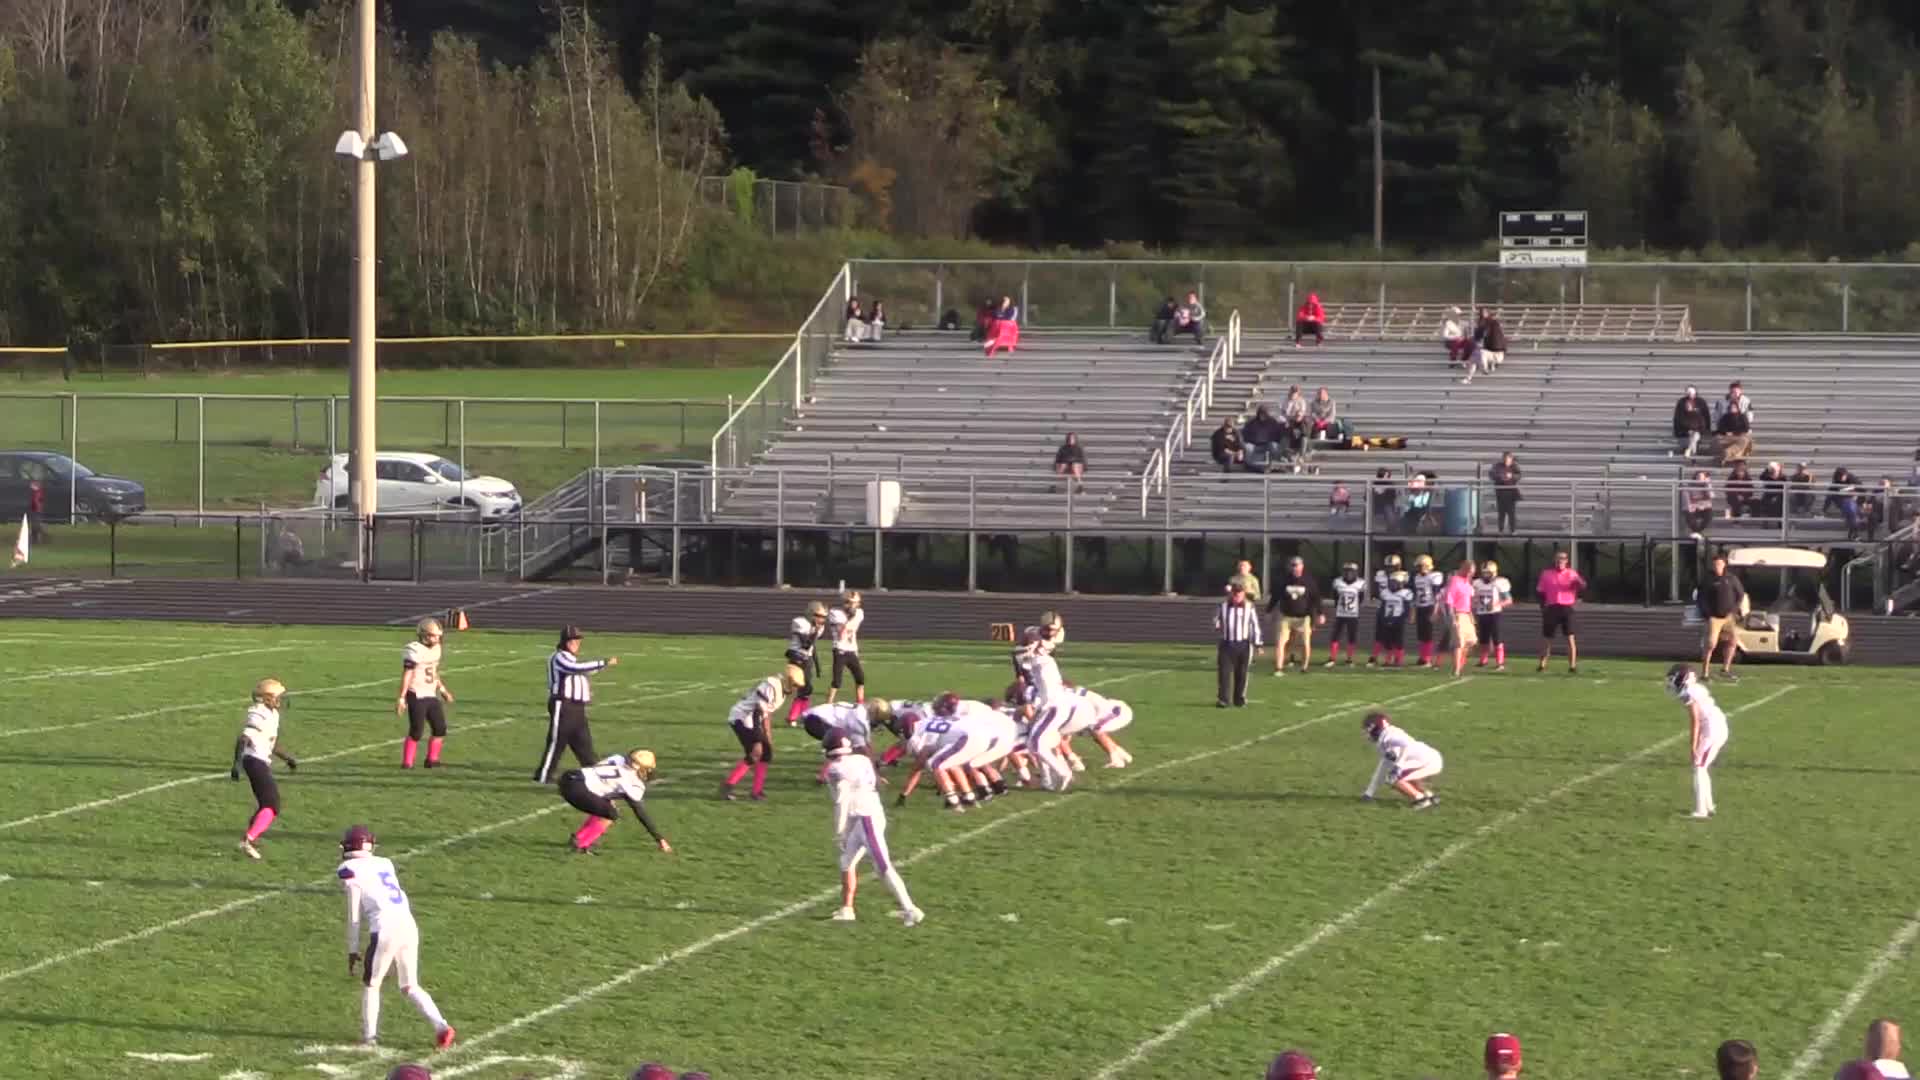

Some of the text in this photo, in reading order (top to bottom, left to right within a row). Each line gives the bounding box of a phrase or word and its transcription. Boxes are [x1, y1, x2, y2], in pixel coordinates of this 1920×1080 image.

[992, 624, 1009, 641] 20
[424, 666, 434, 684] 5
[378, 871, 402, 904] 5
